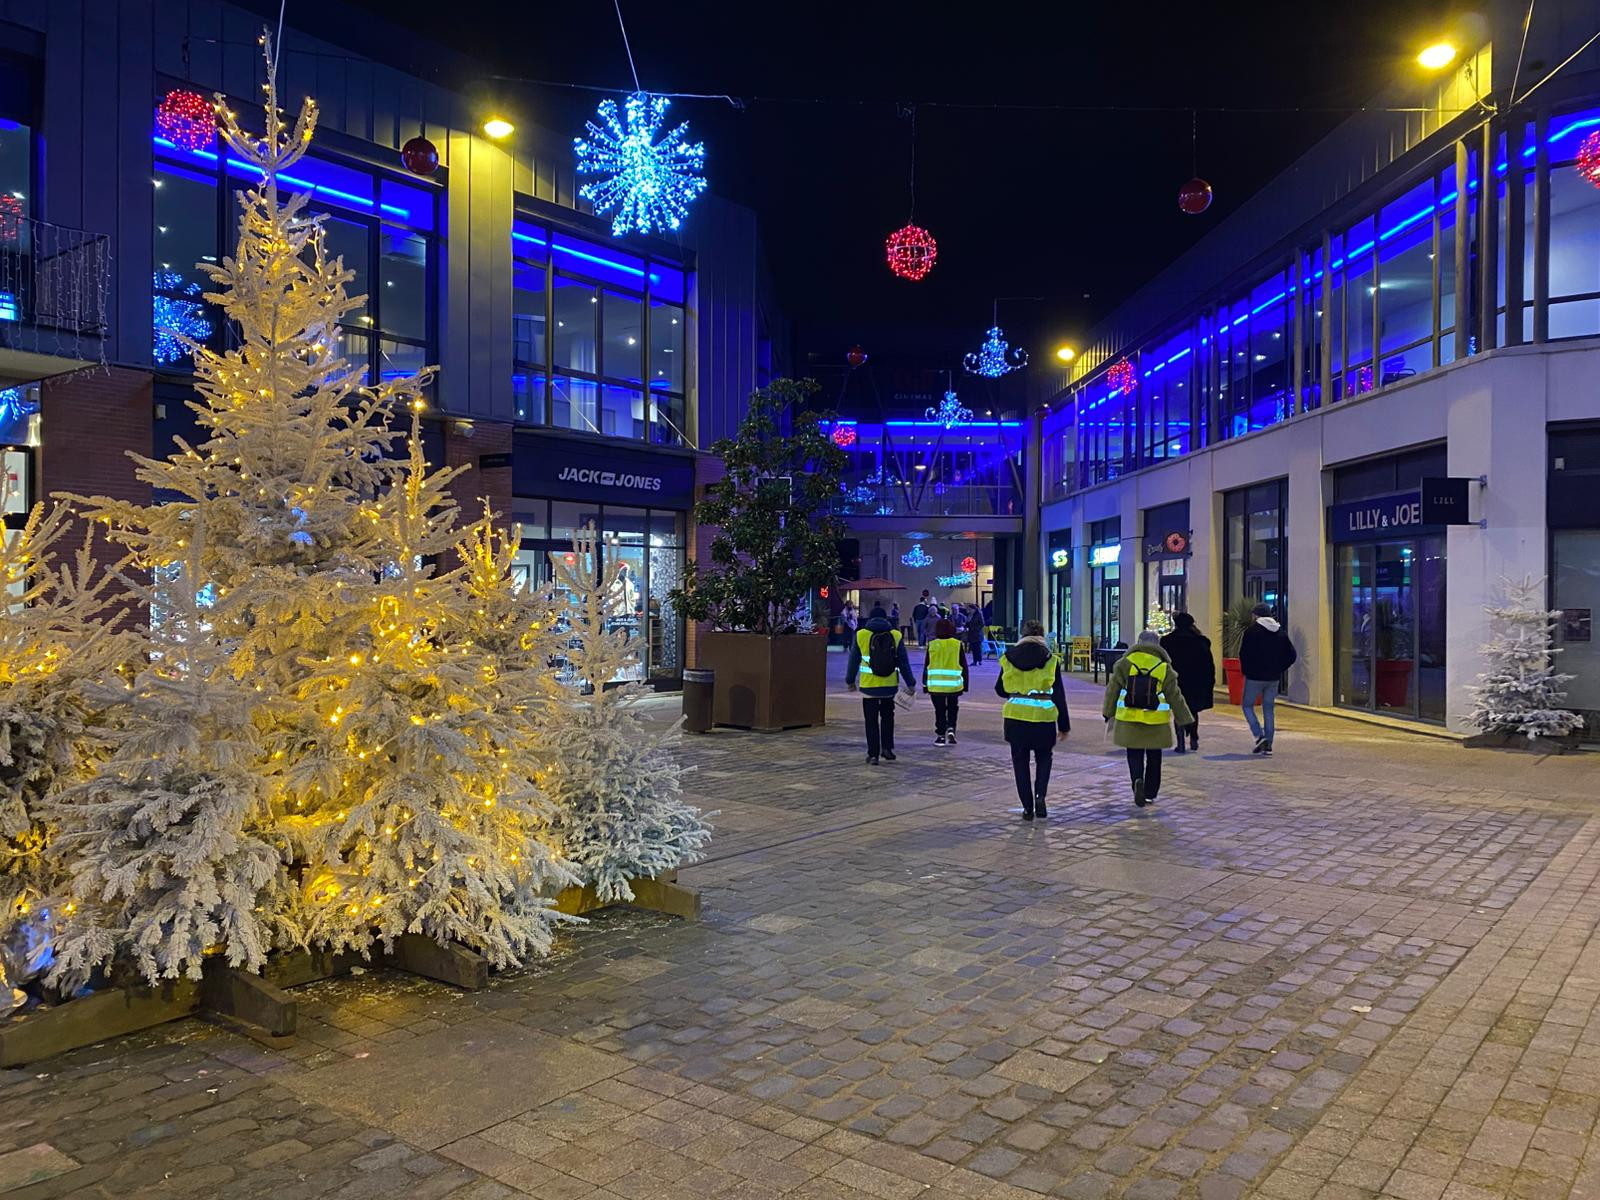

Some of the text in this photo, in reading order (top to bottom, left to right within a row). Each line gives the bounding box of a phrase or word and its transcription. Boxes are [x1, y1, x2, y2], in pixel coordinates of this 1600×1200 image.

[558, 467, 601, 484] JACK
[615, 474, 662, 491] JONES
[1349, 502, 1420, 531] LILLY & JOE
